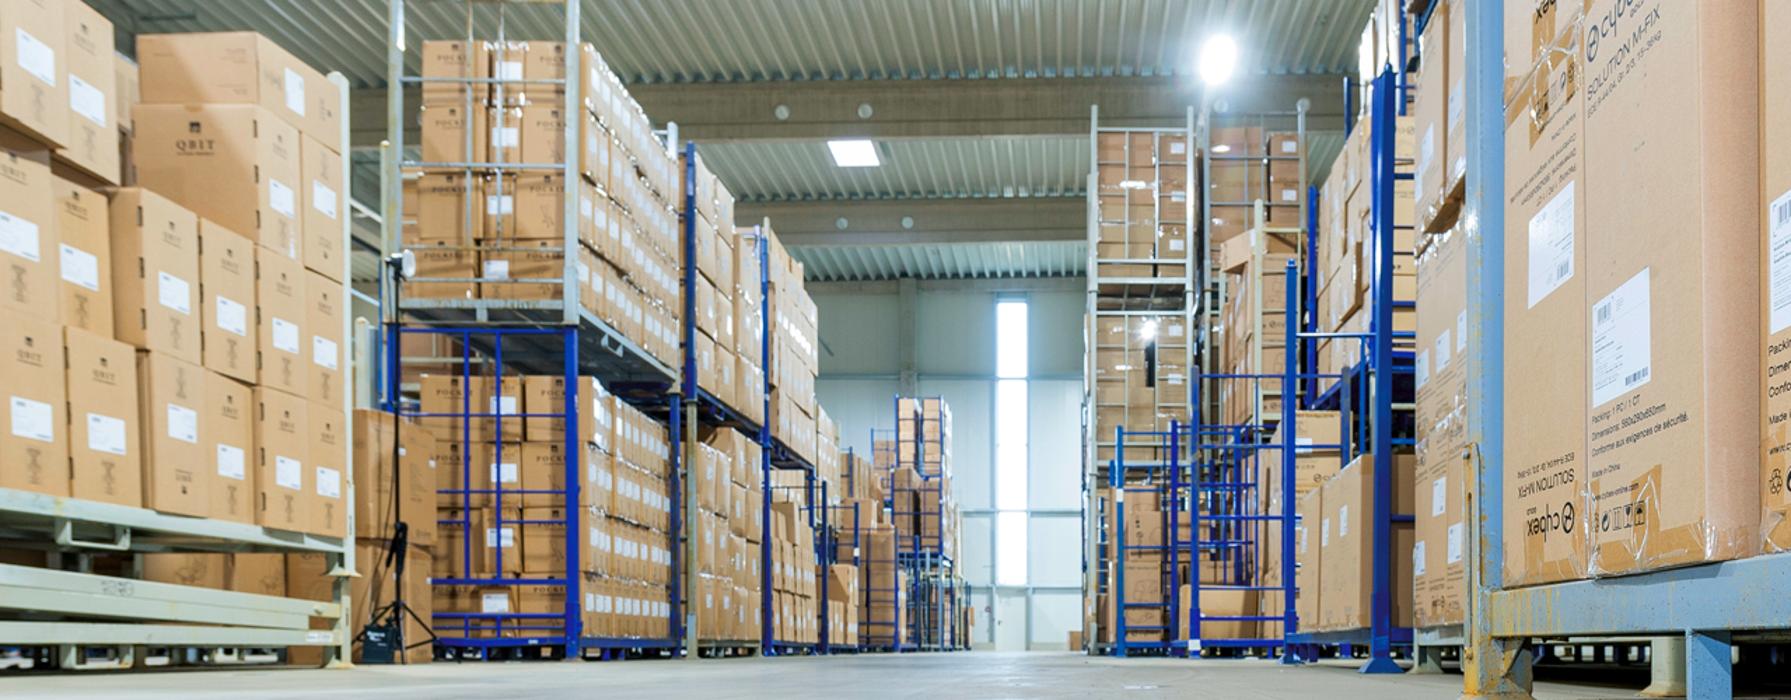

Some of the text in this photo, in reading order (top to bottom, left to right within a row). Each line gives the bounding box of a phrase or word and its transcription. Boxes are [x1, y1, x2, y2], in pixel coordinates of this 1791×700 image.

[1587, 3, 1661, 101] SOLUTION M-FIX
[176, 139, 215, 152] QBIT
[1769, 413, 1788, 425] Made
[1518, 468, 1575, 499] SOLUTION M-FIX
[1527, 504, 1560, 543] cybex
